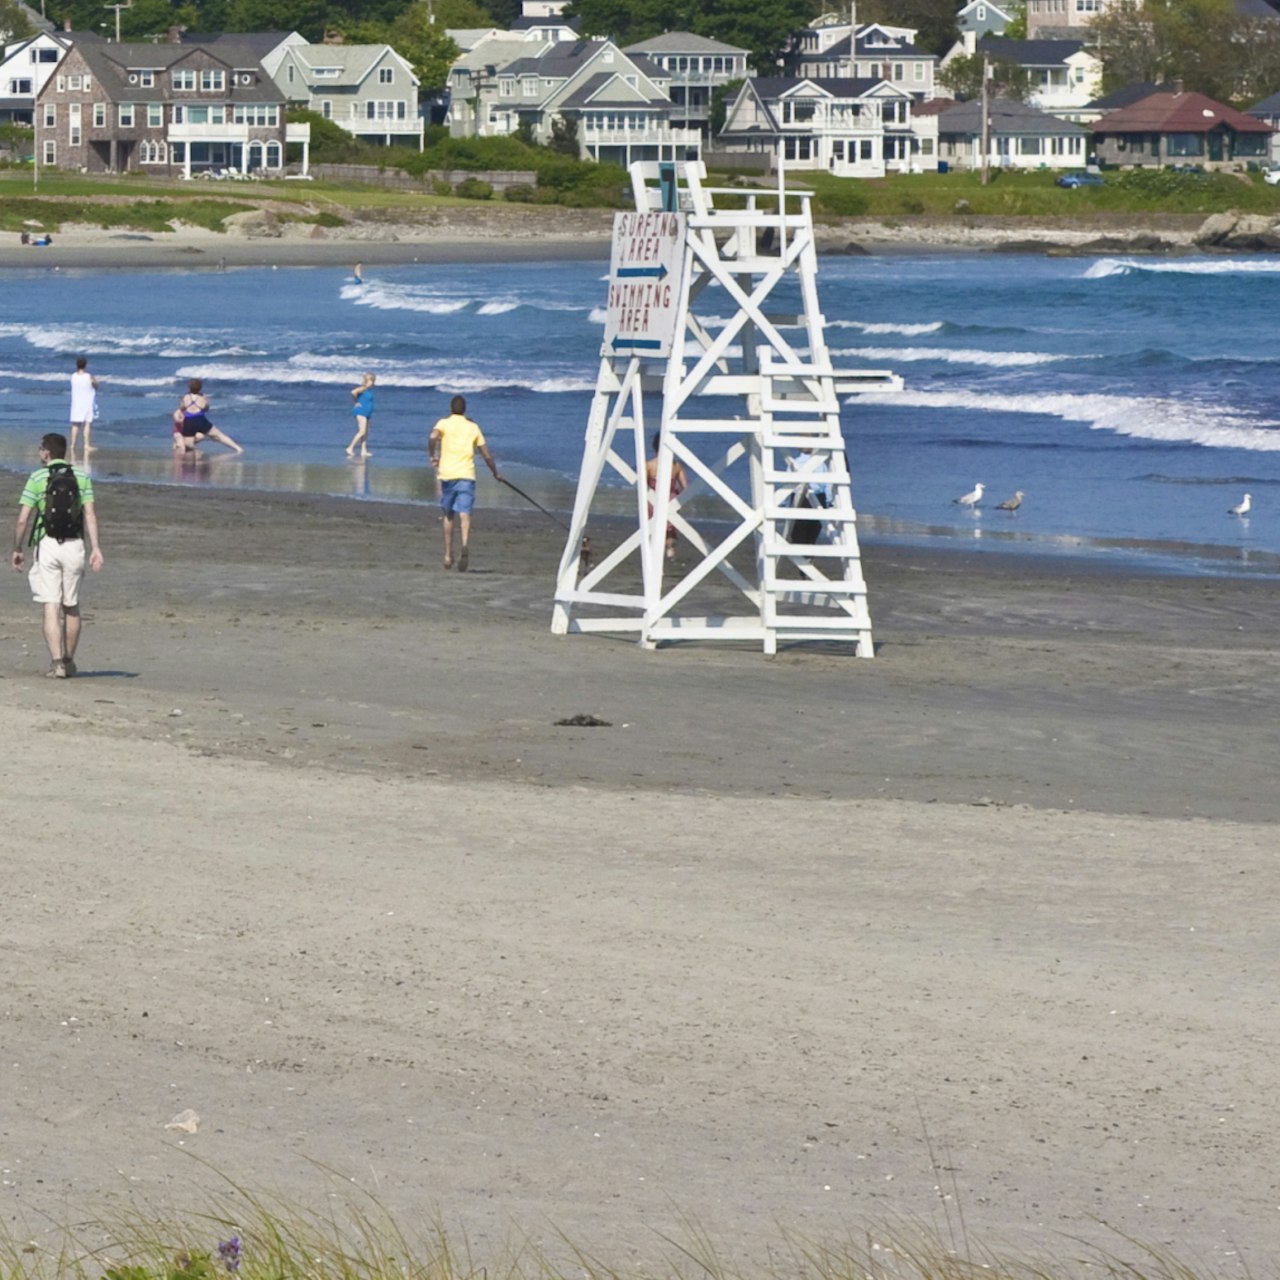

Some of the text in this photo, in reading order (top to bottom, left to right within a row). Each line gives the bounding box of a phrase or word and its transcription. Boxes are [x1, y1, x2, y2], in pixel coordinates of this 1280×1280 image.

[620, 214, 679, 238] SURFING
[627, 238, 660, 261] AREA
[609, 284, 671, 308] SWIMMING
[618, 309, 649, 332] AREA
